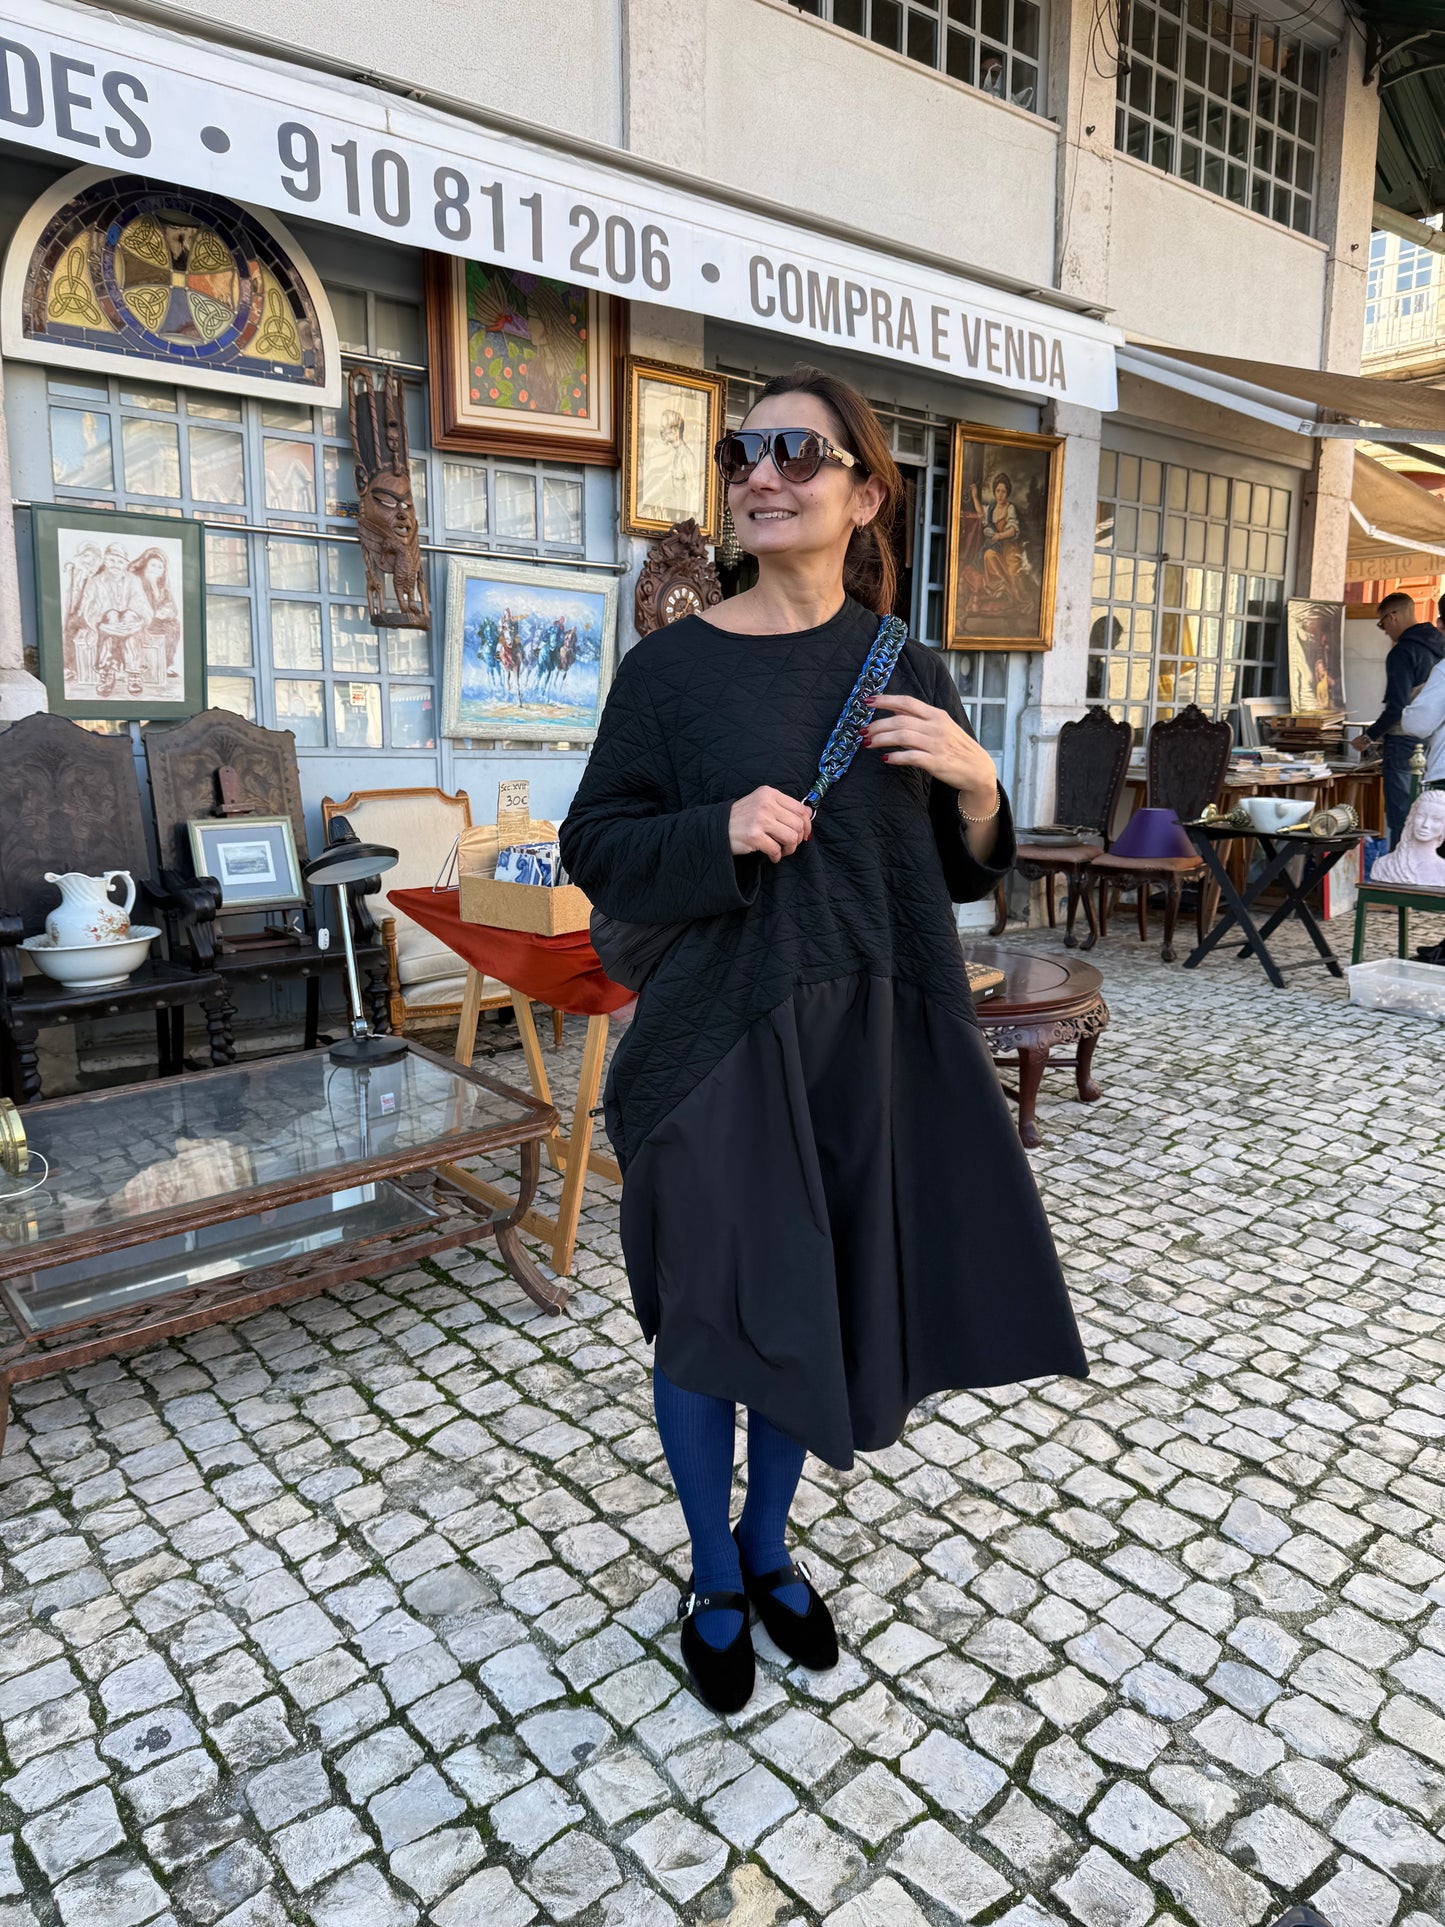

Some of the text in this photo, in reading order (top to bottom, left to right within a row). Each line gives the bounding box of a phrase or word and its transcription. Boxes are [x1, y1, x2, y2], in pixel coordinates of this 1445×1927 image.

[0, 36, 1067, 391] DES 910 811 206 COMPRA E VENDA
